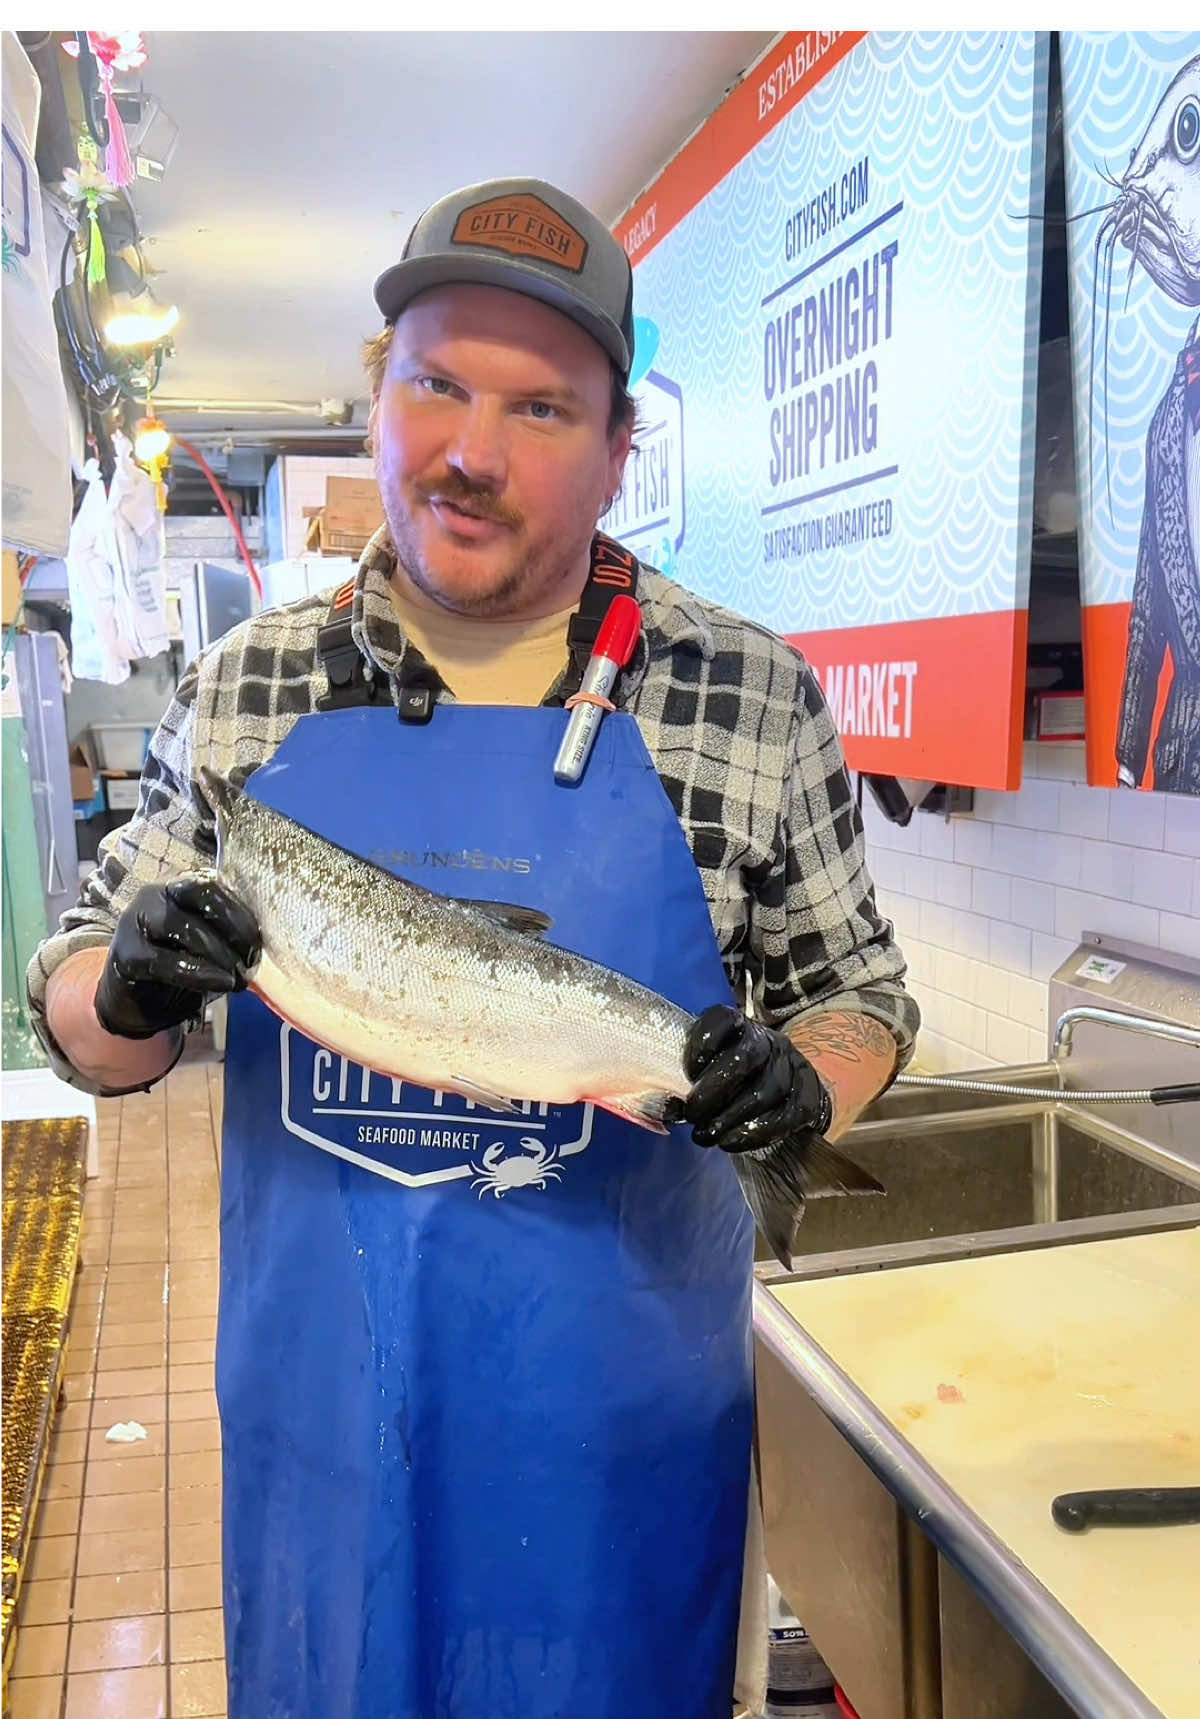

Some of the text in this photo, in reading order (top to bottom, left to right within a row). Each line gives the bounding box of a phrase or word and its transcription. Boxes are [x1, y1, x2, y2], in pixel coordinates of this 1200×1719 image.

[470, 212, 519, 232] CITY
[525, 216, 571, 255] FISH
[623, 202, 656, 256] LEGACY
[785, 156, 868, 262] CITYFISH.COM
[764, 239, 898, 401] OVERNIGHT
[769, 360, 878, 487] SHIPPING
[634, 438, 669, 518] FISH
[763, 498, 893, 563] SATISFACTION GUARANTEED
[825, 661, 918, 739] MARKET
[357, 1126, 480, 1150] SEAFOOD MARKET
